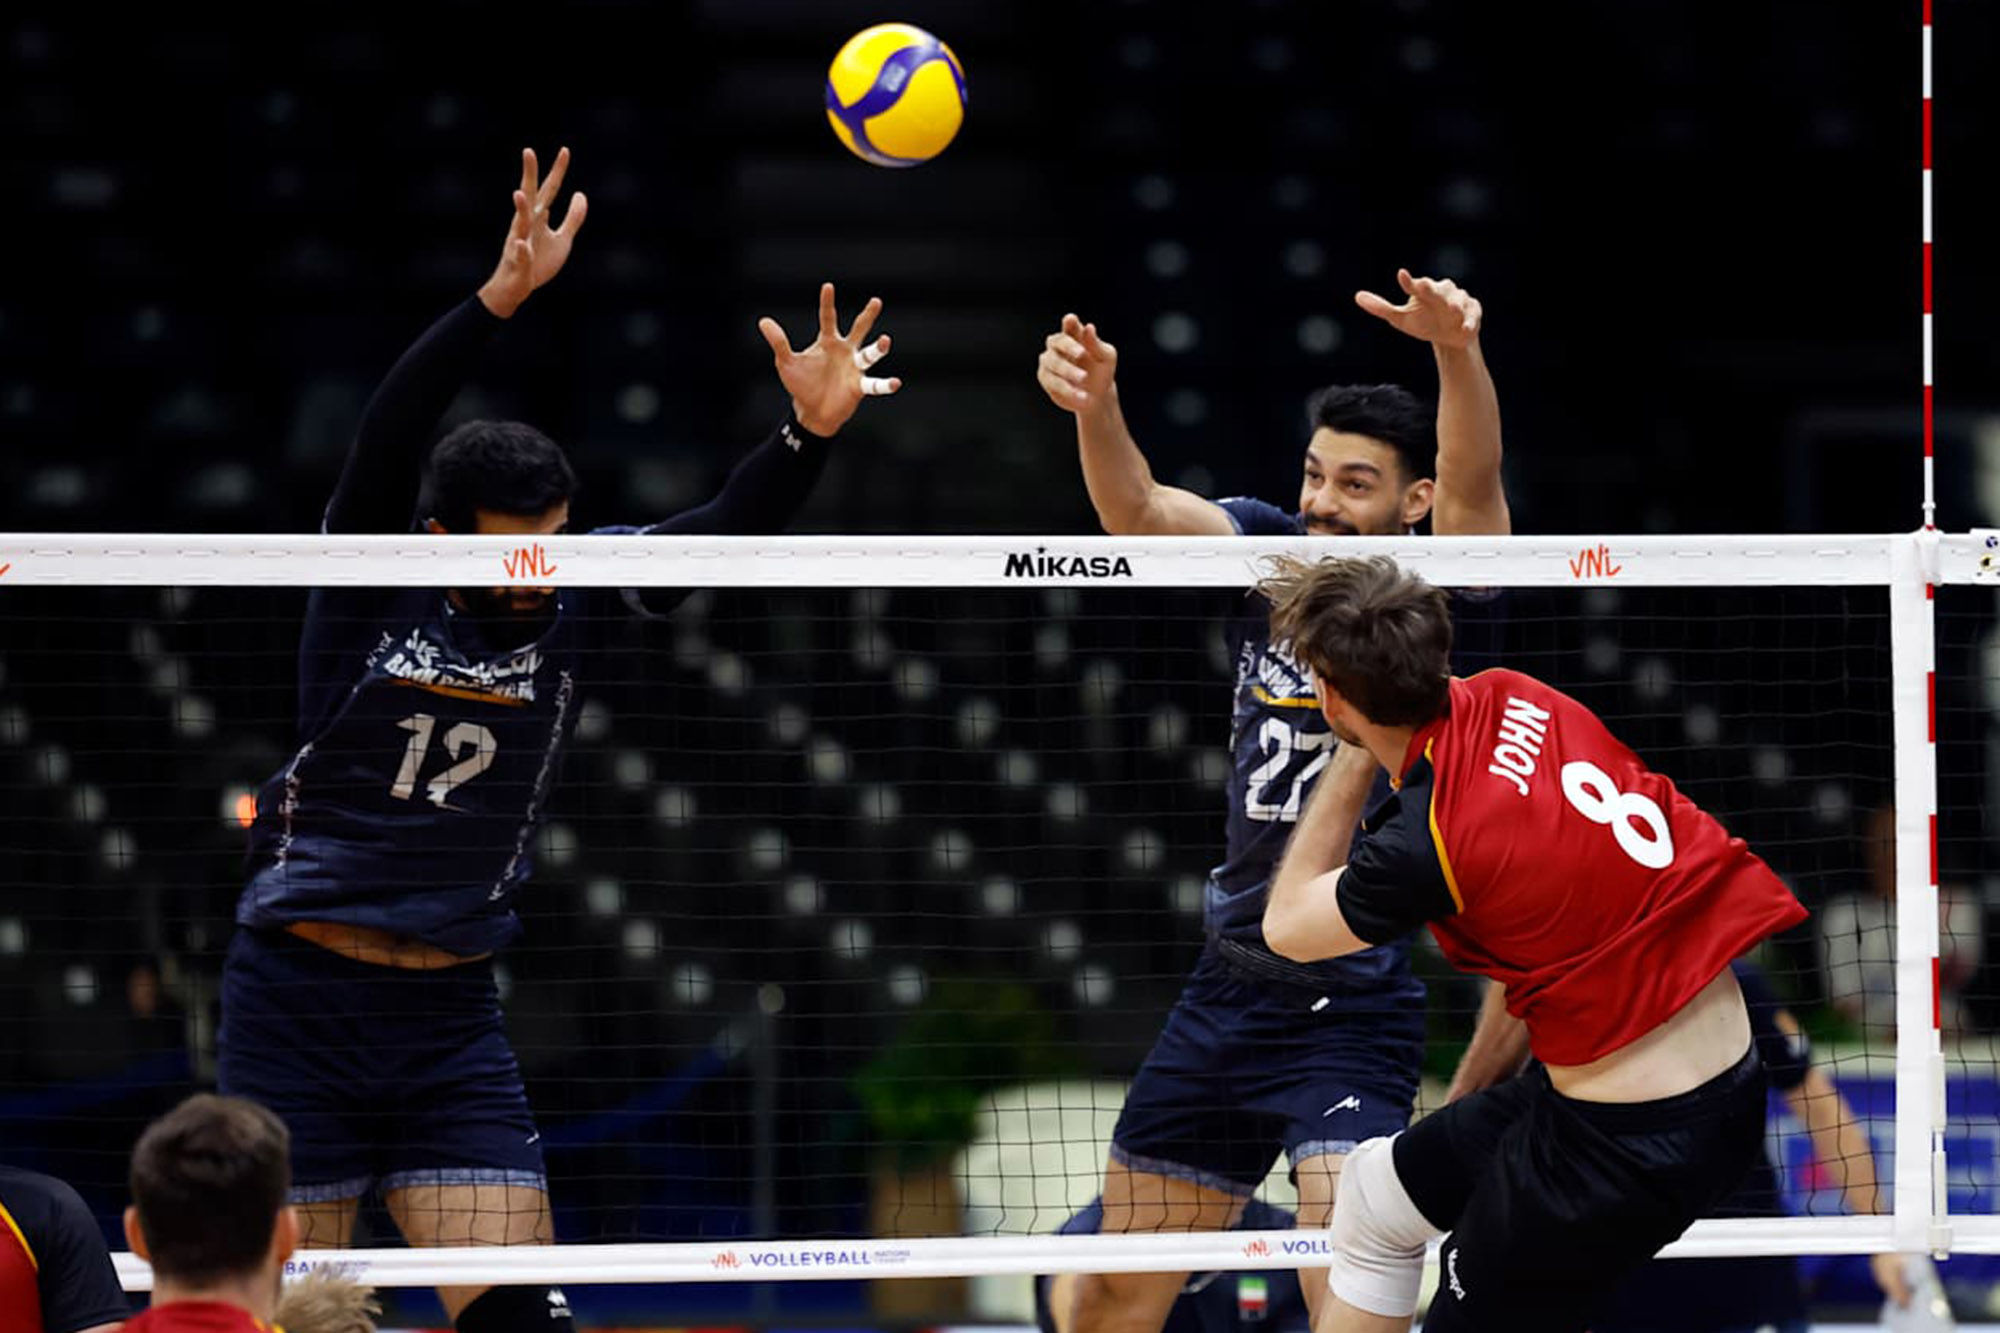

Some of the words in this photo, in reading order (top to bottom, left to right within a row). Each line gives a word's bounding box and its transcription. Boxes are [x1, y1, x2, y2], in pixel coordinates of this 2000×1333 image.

[503, 543, 556, 578] VNL
[1569, 543, 1621, 578] VNL
[389, 713, 498, 812] 12
[1245, 717, 1338, 822] 27
[1488, 697, 1550, 796] JOHN
[1561, 761, 1674, 869] 8
[711, 1250, 741, 1268] VNL
[751, 1251, 871, 1266] VOLLEYBALL
[1244, 1239, 1271, 1257] VNL
[1283, 1241, 1332, 1254] VOLL
